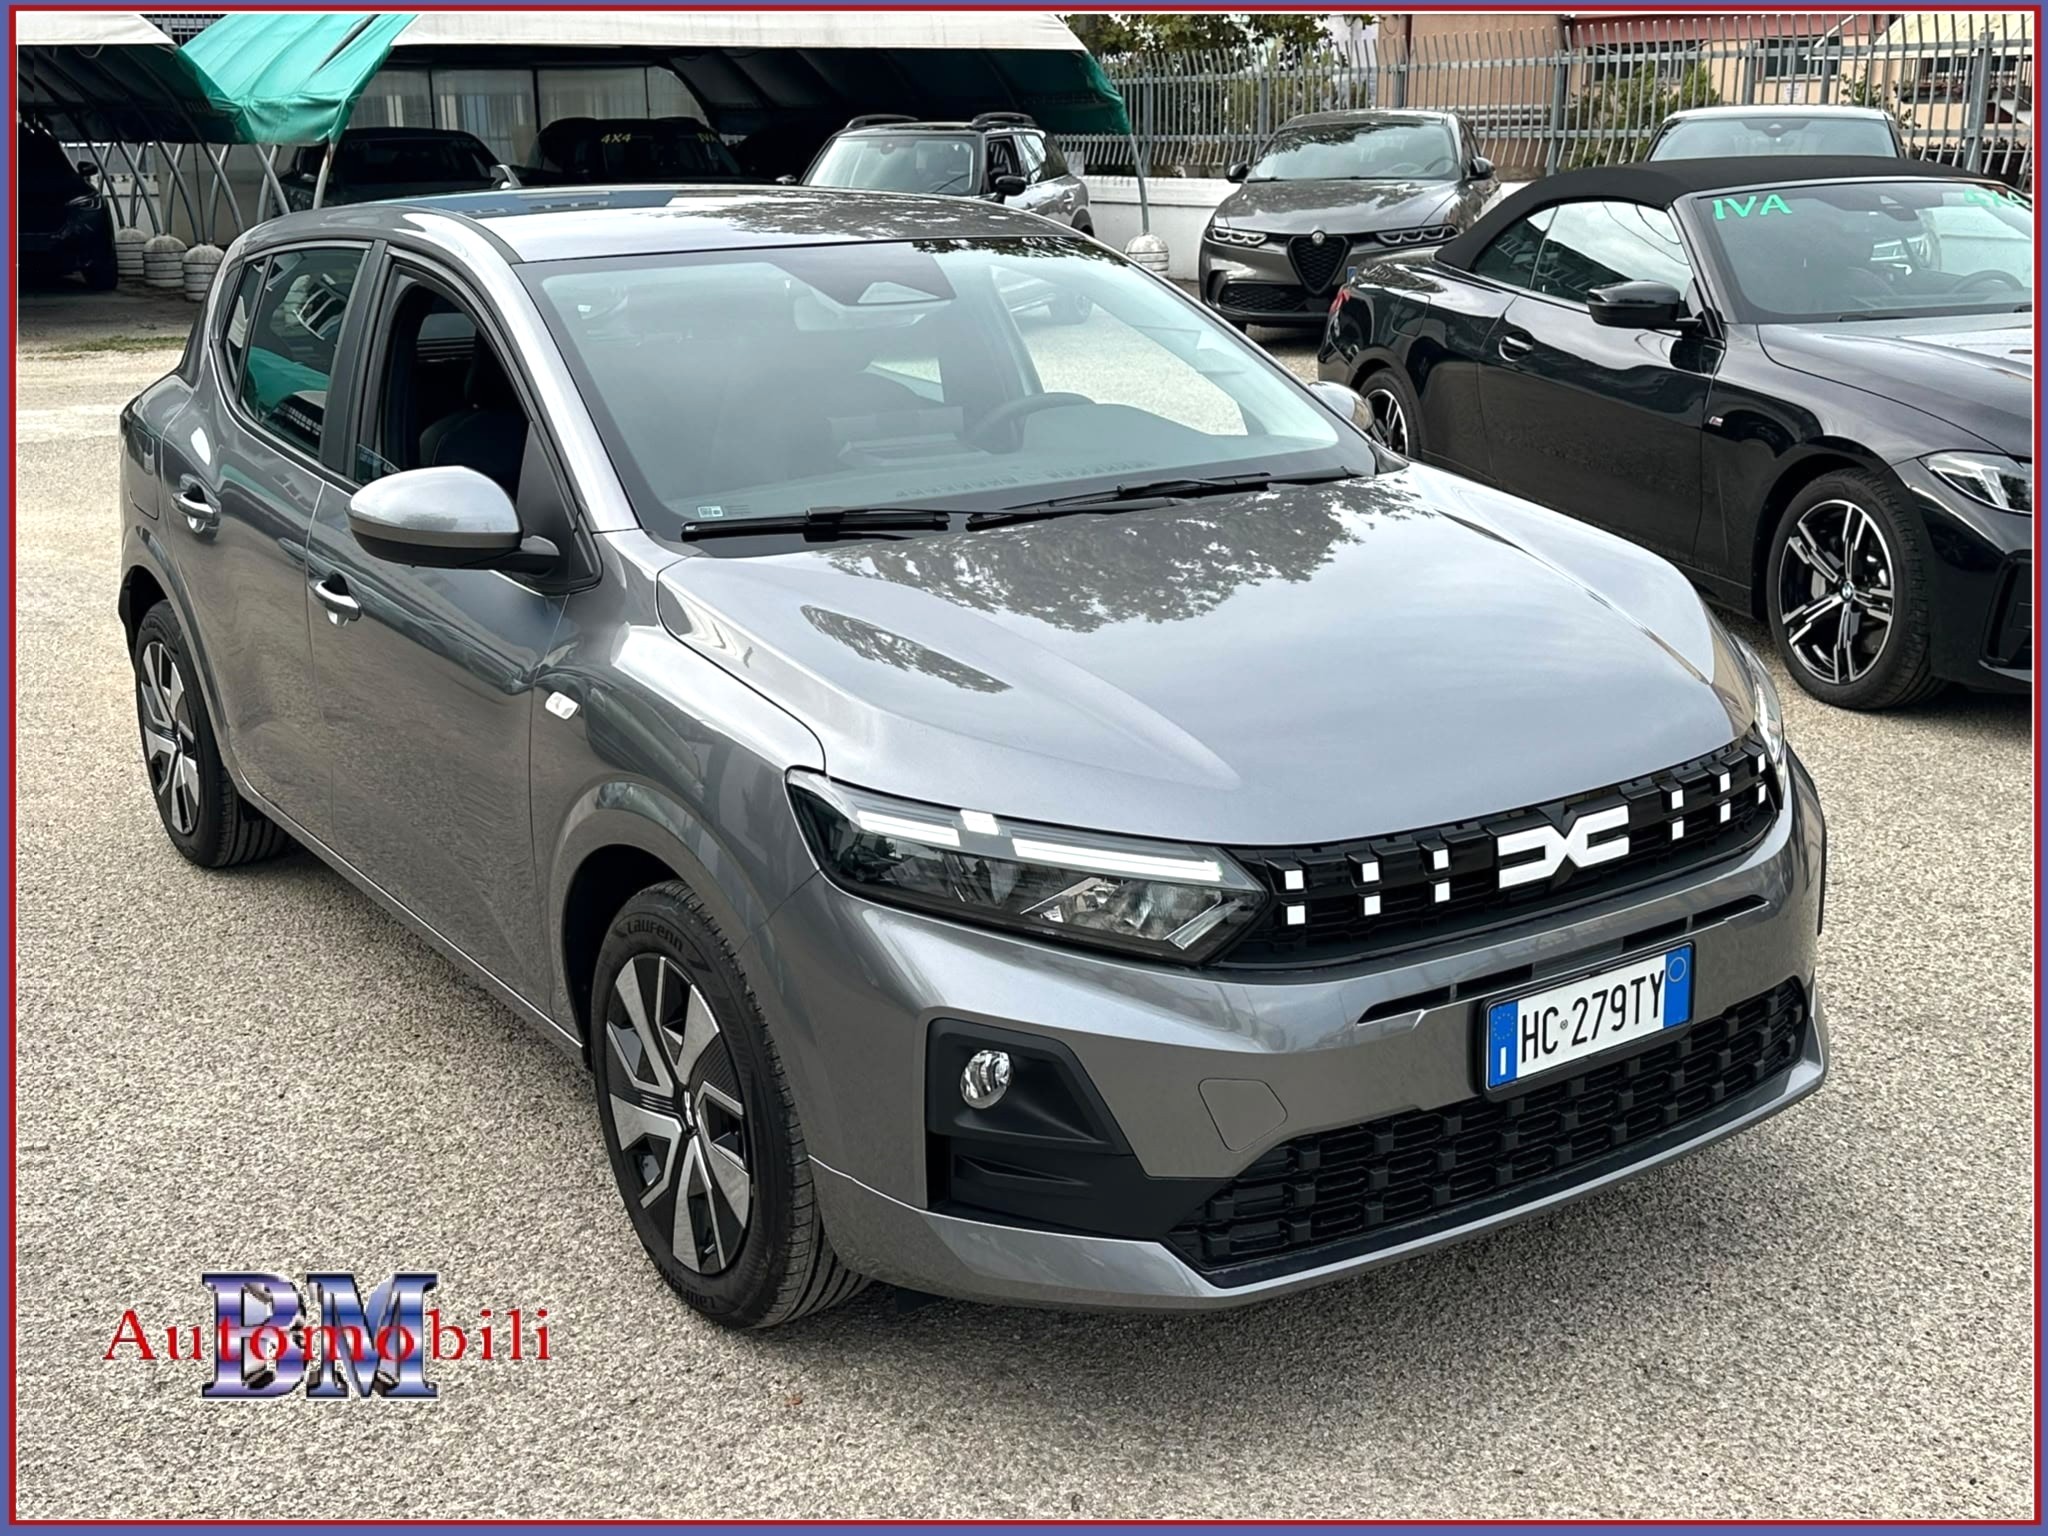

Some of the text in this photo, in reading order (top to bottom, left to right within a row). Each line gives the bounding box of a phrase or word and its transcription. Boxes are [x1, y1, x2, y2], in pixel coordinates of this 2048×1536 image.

[1711, 194, 1793, 220] IVA
[1520, 1005, 1559, 1064] HC
[1570, 969, 1665, 1048] 279TY
